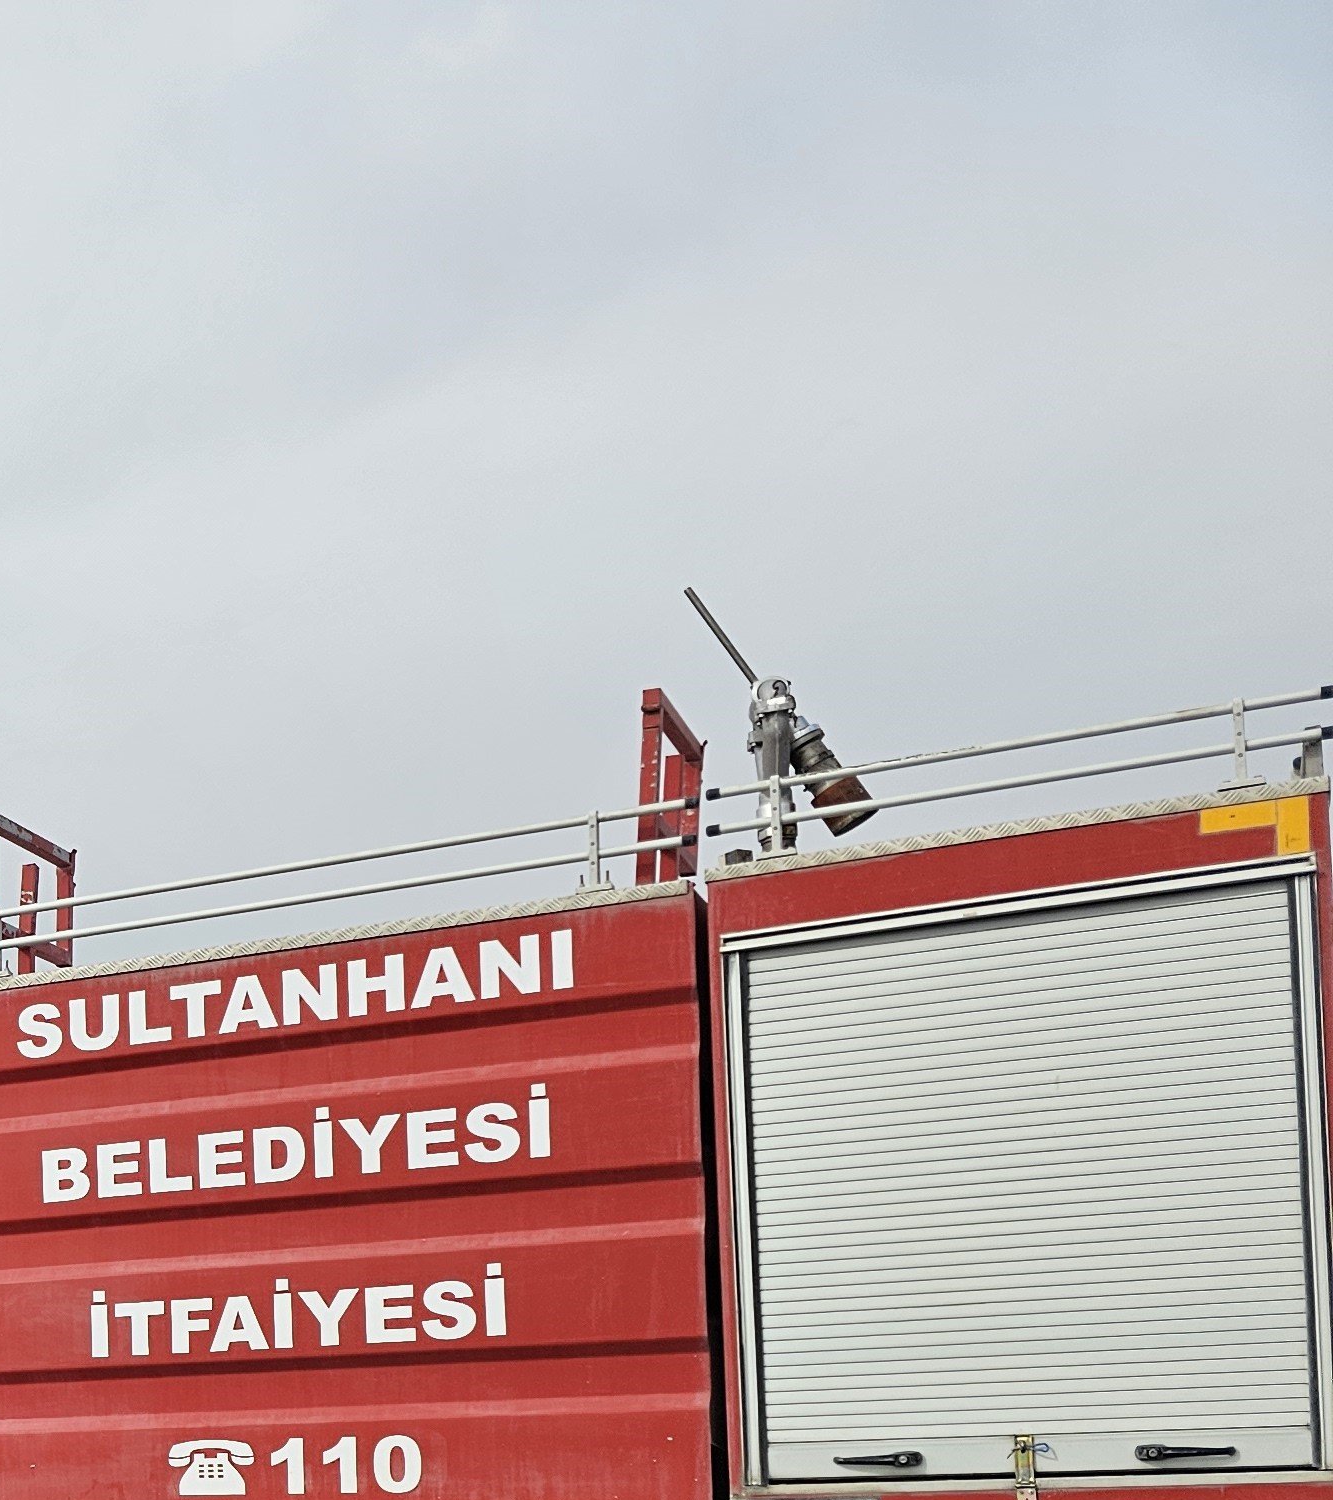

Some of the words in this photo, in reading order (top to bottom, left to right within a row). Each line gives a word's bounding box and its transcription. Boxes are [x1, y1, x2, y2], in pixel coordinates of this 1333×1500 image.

[17, 928, 574, 1059] SULTANHANI
[41, 1082, 551, 1204] BELEDİYESİ
[90, 1262, 507, 1358] İTFAİYESİ
[270, 1434, 422, 1495] 110
